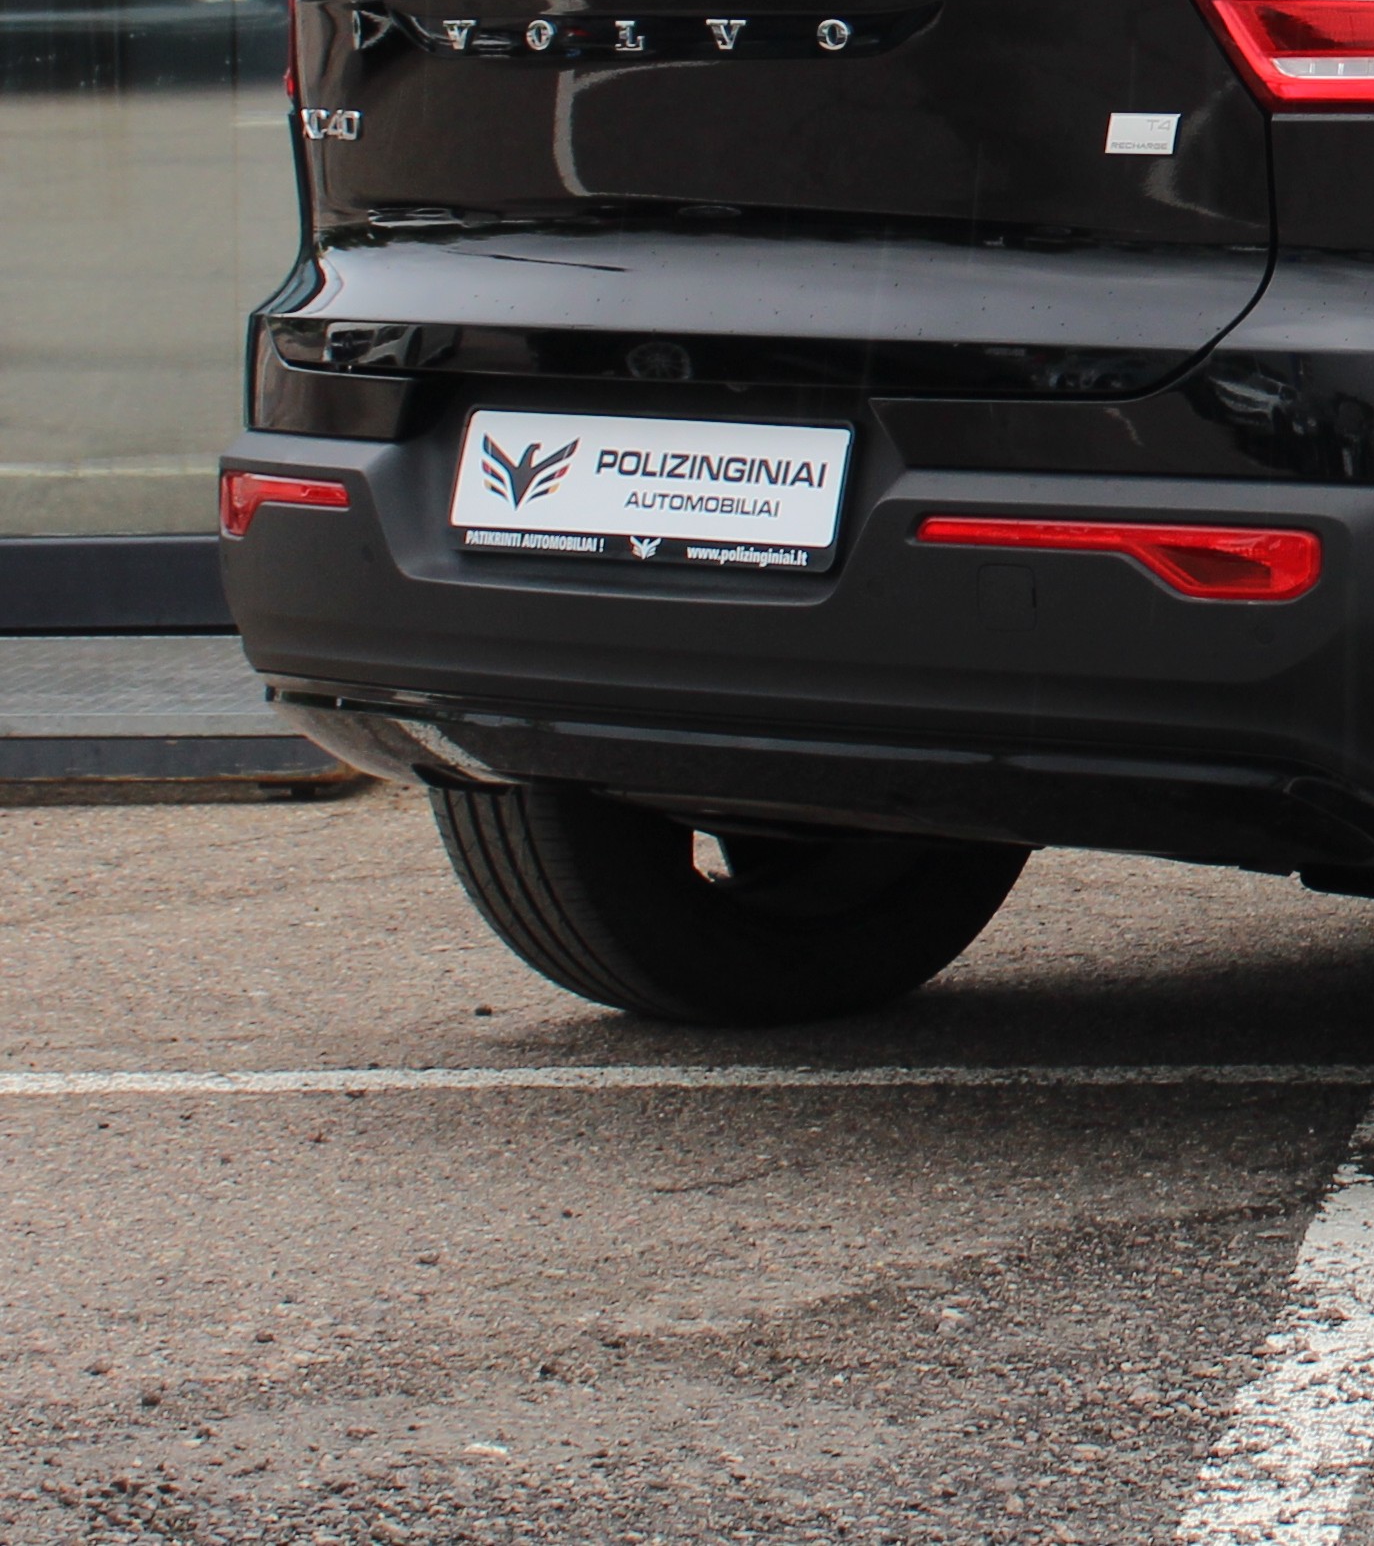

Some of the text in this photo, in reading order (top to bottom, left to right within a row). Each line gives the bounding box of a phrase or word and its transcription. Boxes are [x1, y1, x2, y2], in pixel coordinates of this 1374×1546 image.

[441, 18, 853, 52] VOLVO
[301, 108, 361, 141] XC40
[1146, 119, 1172, 132] T4
[1110, 141, 1169, 151] RECHARGE
[595, 448, 829, 489] POLIZINGINIAI
[624, 490, 781, 518] AUTOMOBILIAI
[464, 530, 521, 548] PATIKRINTI
[521, 533, 597, 552] AUTOMOBILIAI
[686, 545, 809, 568] www.polizinginiai.lt
